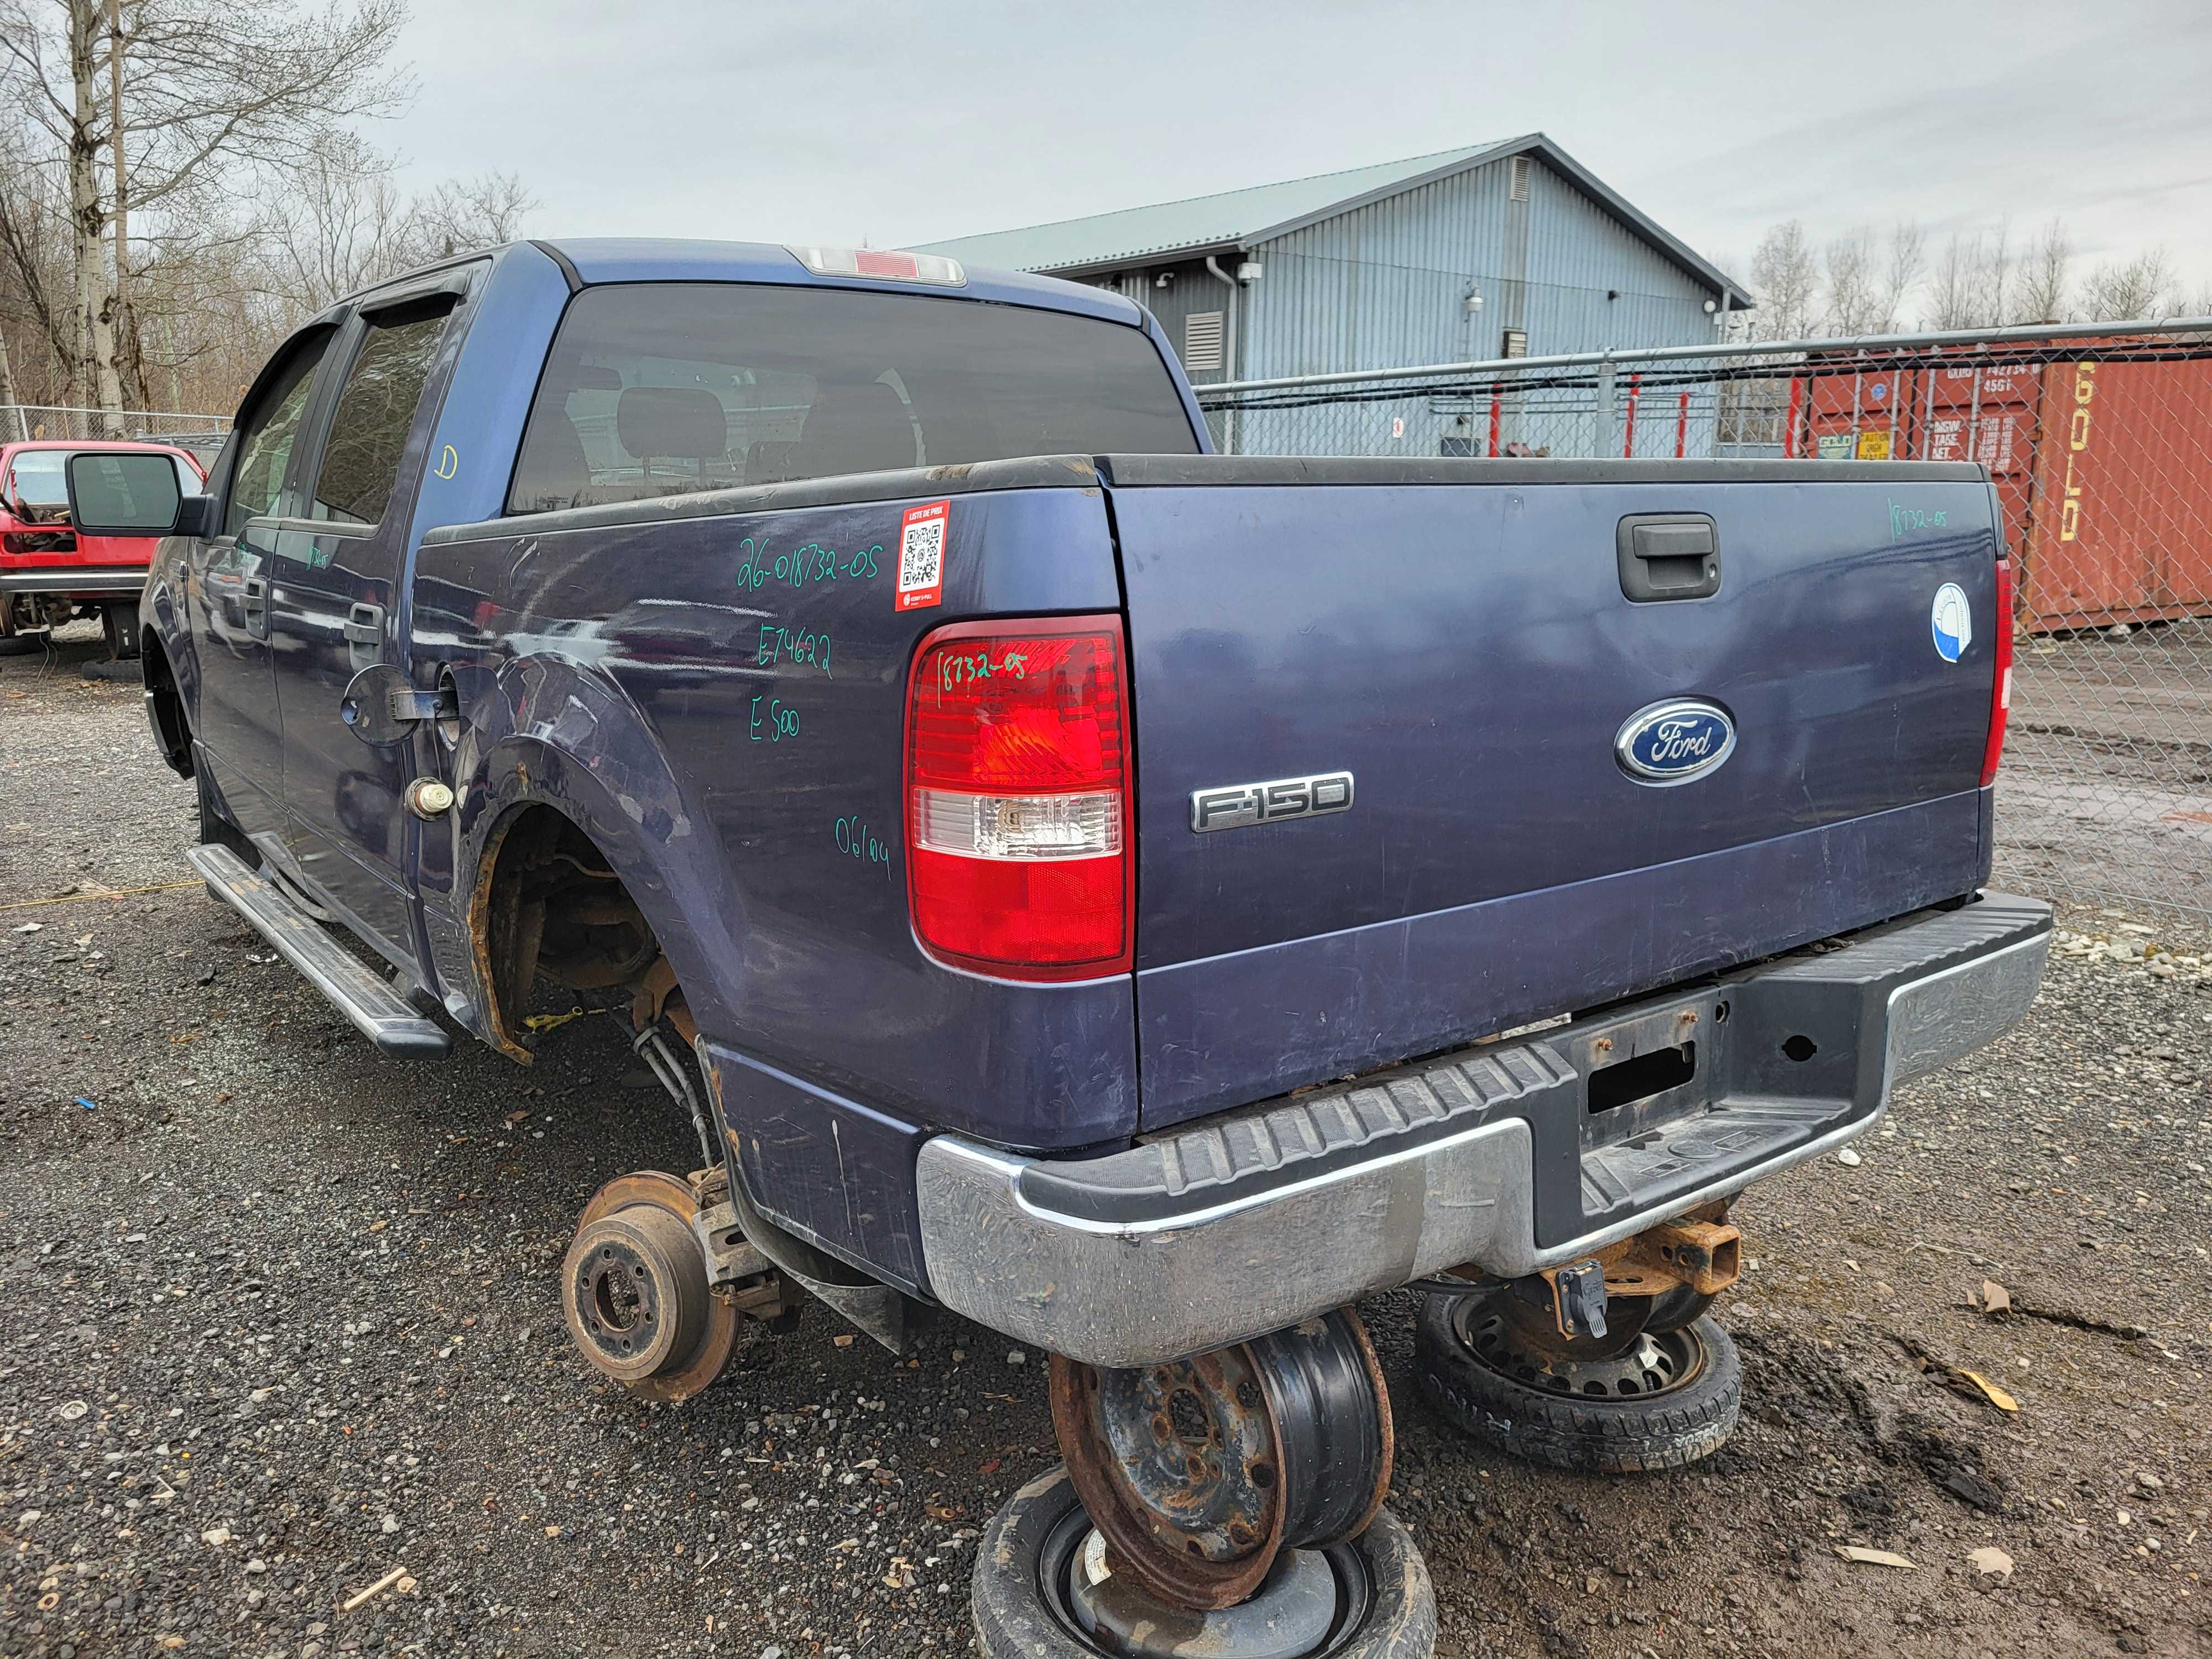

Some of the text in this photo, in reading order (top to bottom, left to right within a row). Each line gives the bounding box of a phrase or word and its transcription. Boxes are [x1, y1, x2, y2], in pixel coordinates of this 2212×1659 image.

[434, 445, 458, 479] D
[2060, 361, 2095, 541] GOLD
[909, 505, 943, 521] LISTE DE PRIX
[1887, 497, 1947, 545] 18732-05
[738, 538, 883, 593] 26-018732-05
[759, 623, 833, 680] E74622
[938, 652, 1027, 709] 18732-05
[1651, 719, 1713, 762] Ford
[1198, 776, 1351, 829] F-150
